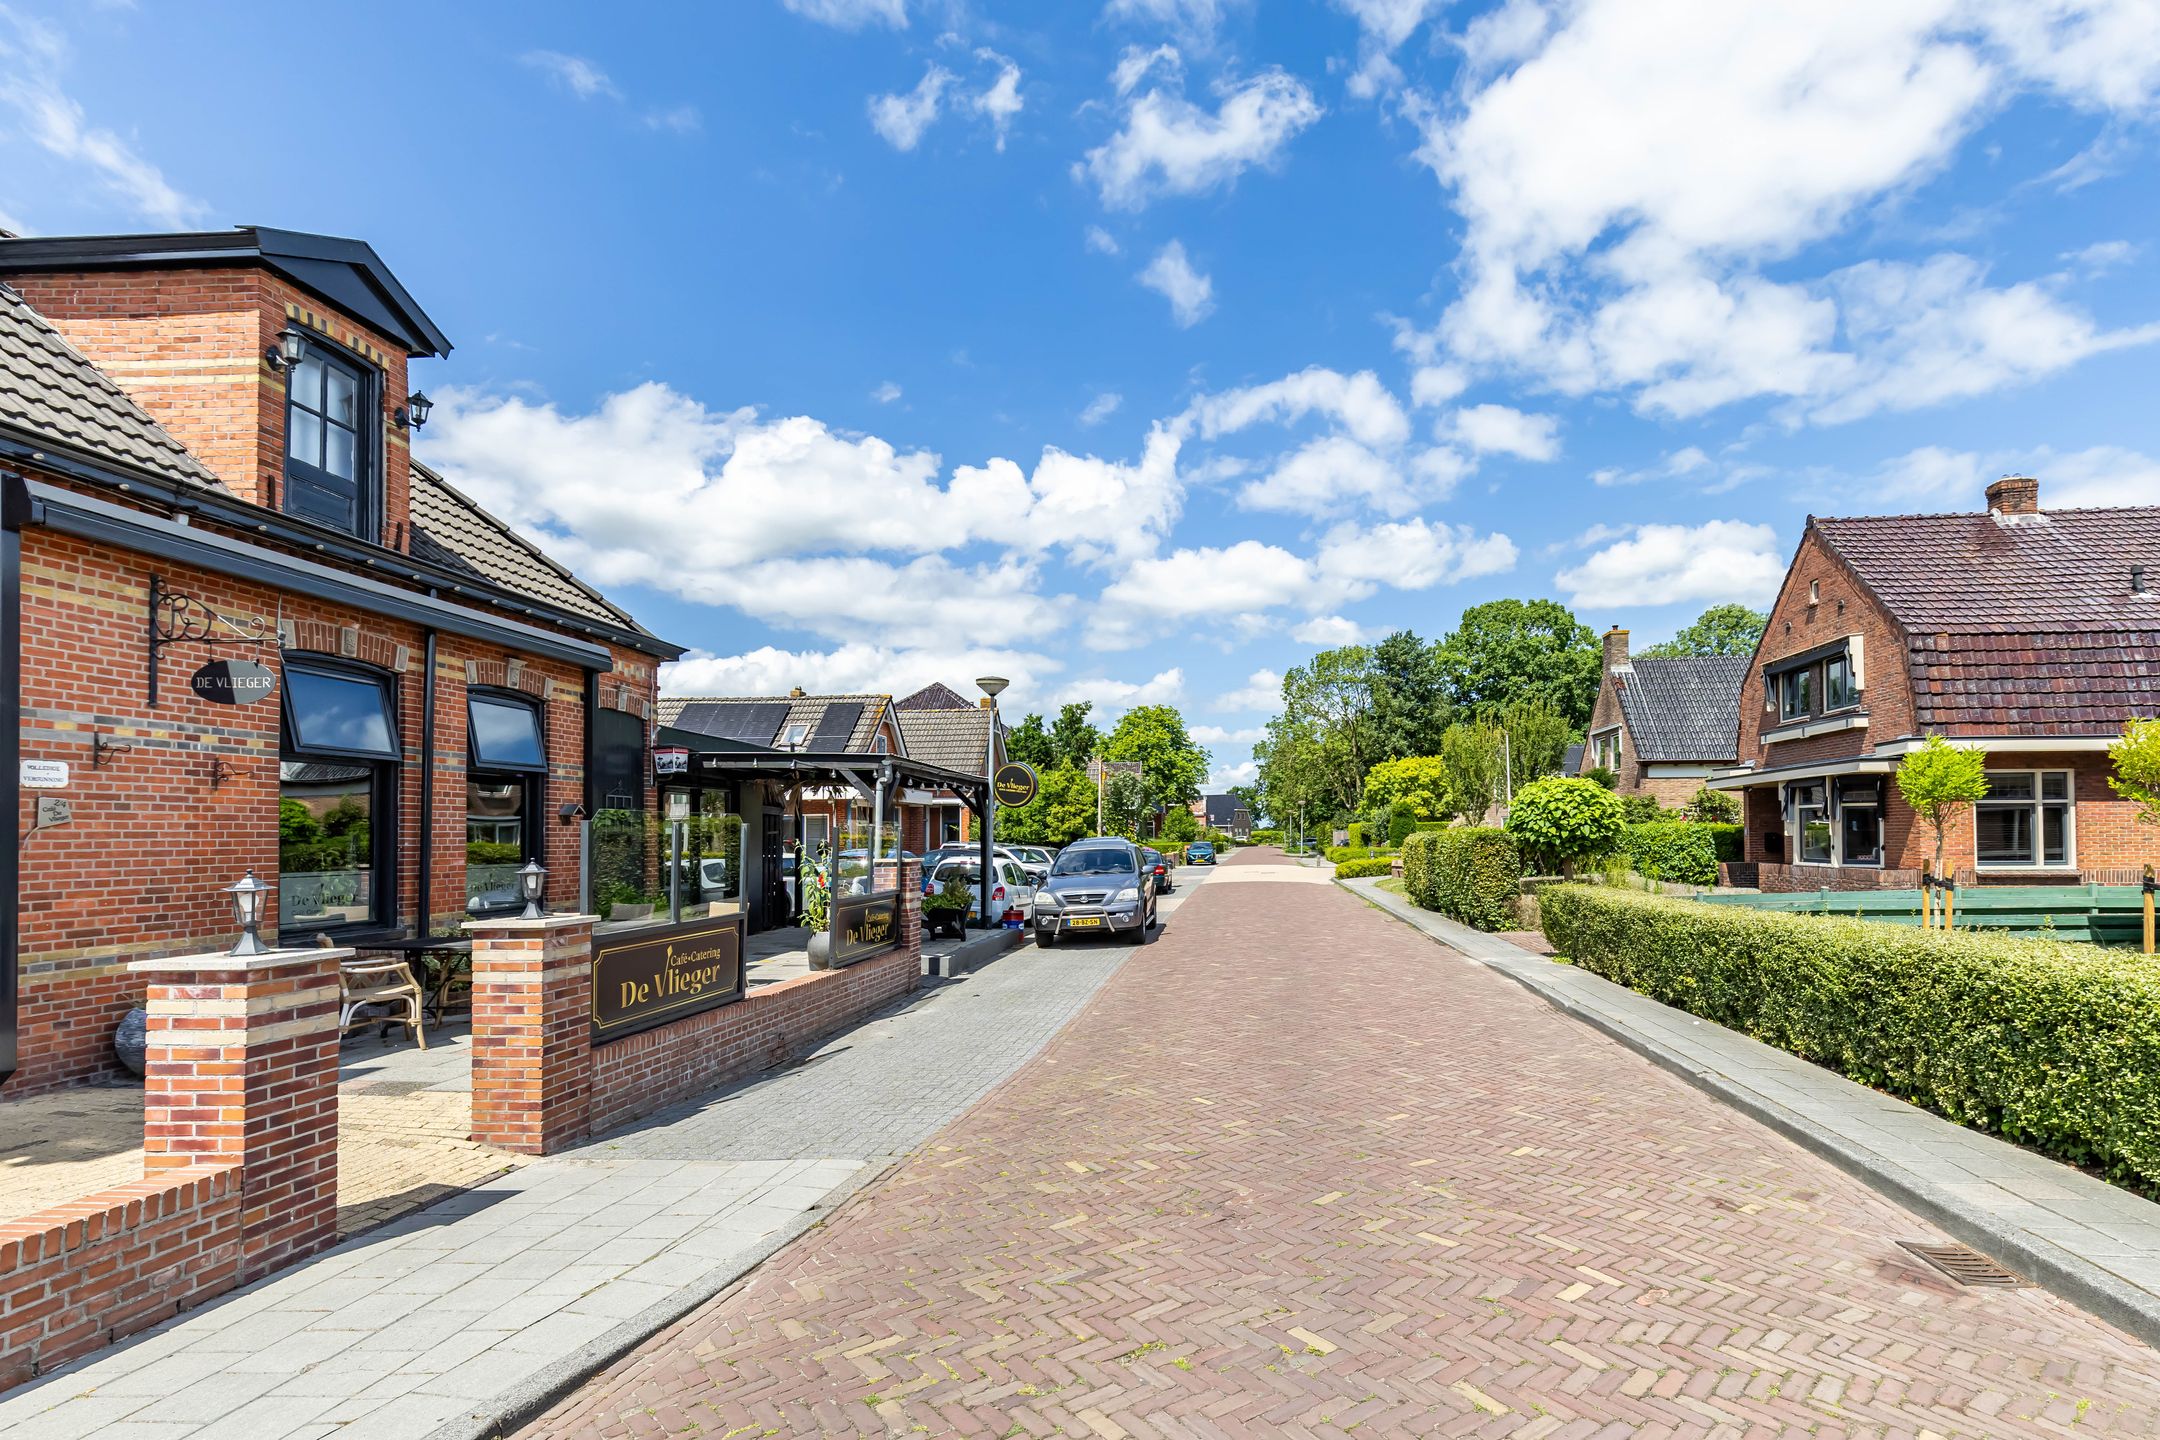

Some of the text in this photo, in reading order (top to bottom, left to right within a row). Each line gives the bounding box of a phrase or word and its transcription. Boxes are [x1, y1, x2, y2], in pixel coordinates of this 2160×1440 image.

[196, 676, 271, 689] DE VLIEGER
[846, 923, 889, 947] De Vlieger
[690, 947, 721, 962] Catering
[620, 963, 720, 1009] De Vlieger
